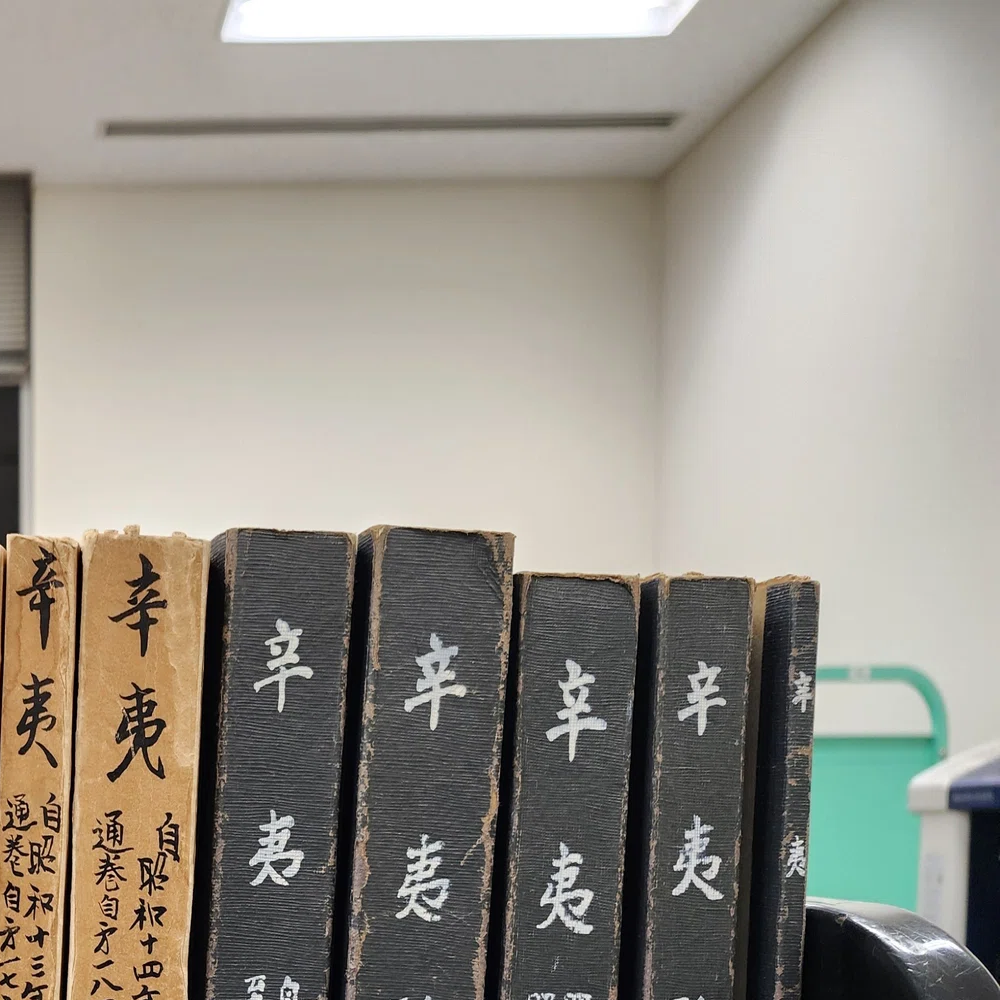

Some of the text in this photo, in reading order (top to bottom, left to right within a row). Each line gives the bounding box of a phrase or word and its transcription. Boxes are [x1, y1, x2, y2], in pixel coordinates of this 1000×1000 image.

[16, 547, 63, 768] 辛夷
[107, 553, 167, 782] 辛夷
[249, 618, 313, 886] 辛夷
[396, 632, 466, 921] 辛夷
[786, 671, 813, 878] 辛夷
[536, 659, 607, 934] 辛夷
[672, 661, 726, 900] 辛夷
